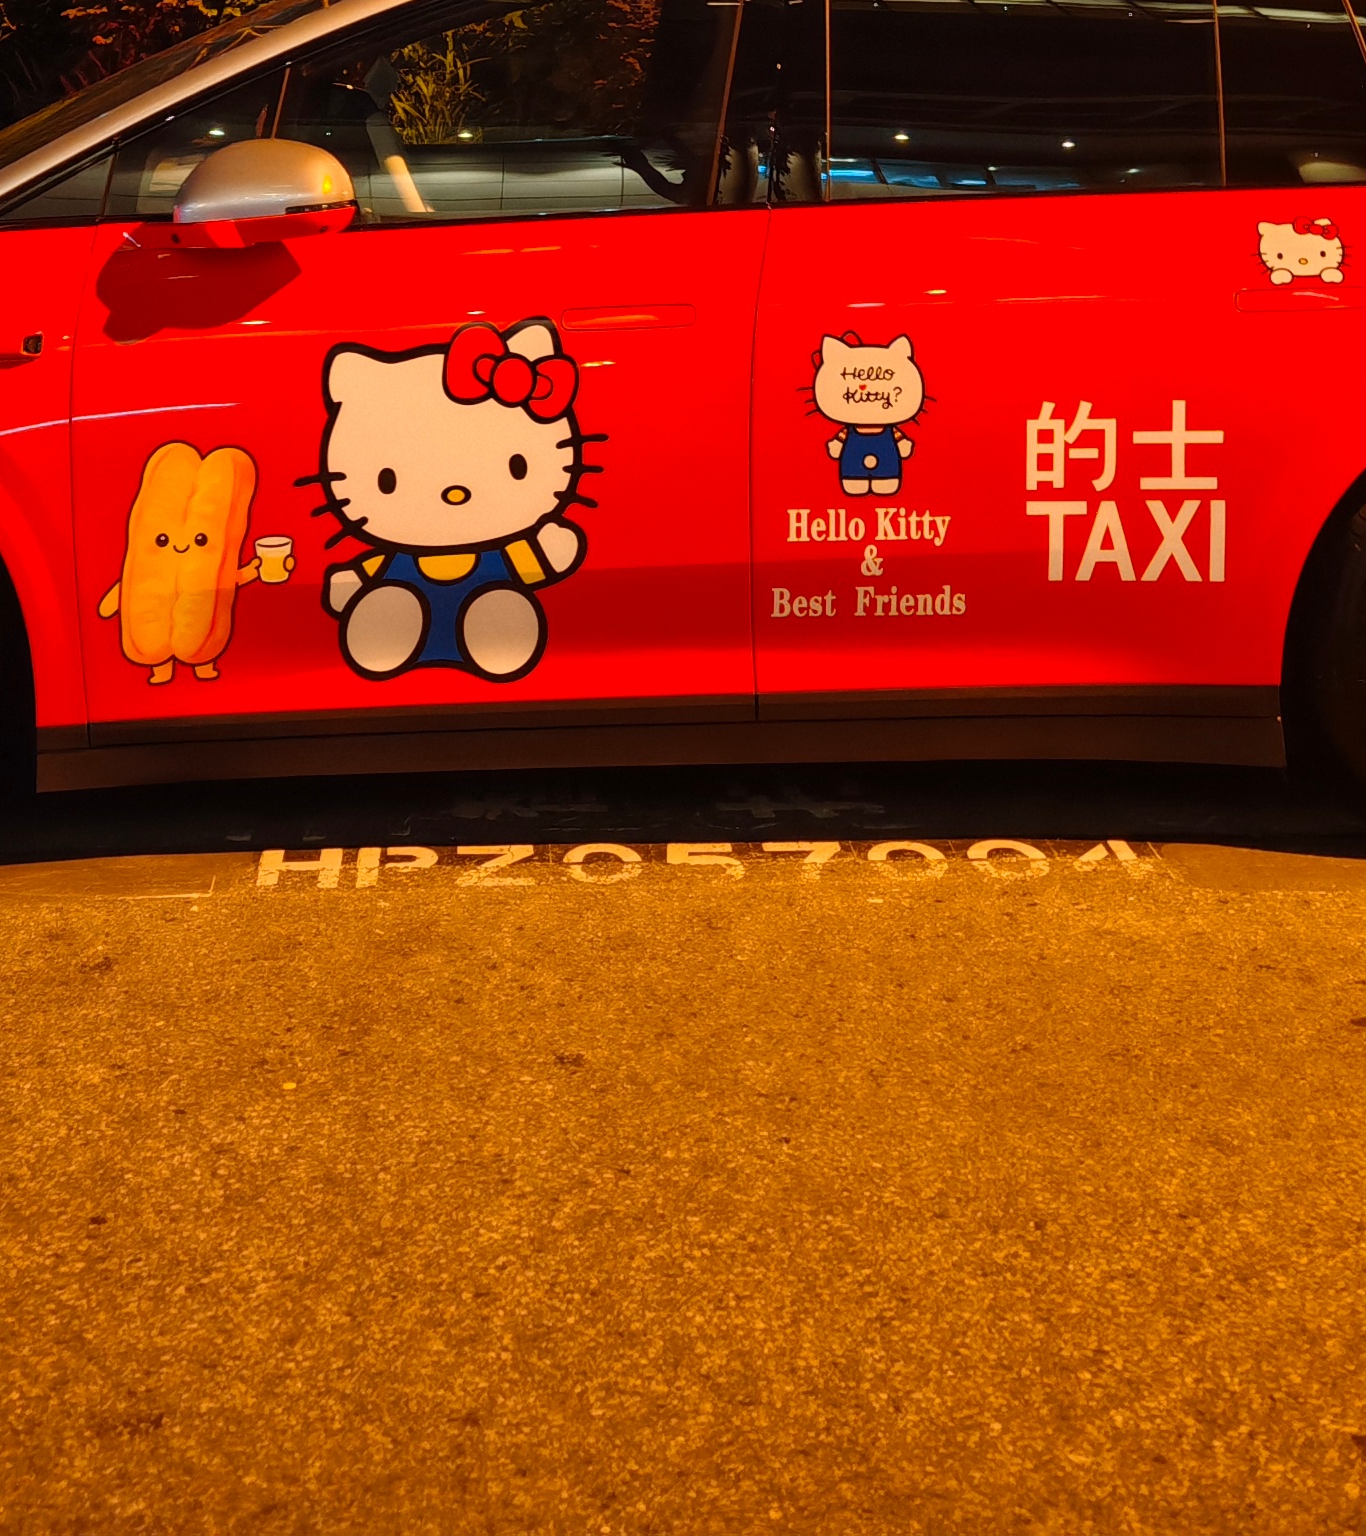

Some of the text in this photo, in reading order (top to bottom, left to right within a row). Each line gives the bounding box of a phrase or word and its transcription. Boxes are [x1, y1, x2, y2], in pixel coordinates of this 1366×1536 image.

[840, 366, 896, 381] Hello
[842, 386, 902, 409] Kitty?
[1026, 400, 1224, 492] 的士
[787, 508, 951, 546] Hello Kitty
[1026, 500, 1226, 582] TAXI
[860, 545, 884, 576] &
[771, 585, 967, 618] Best Friends
